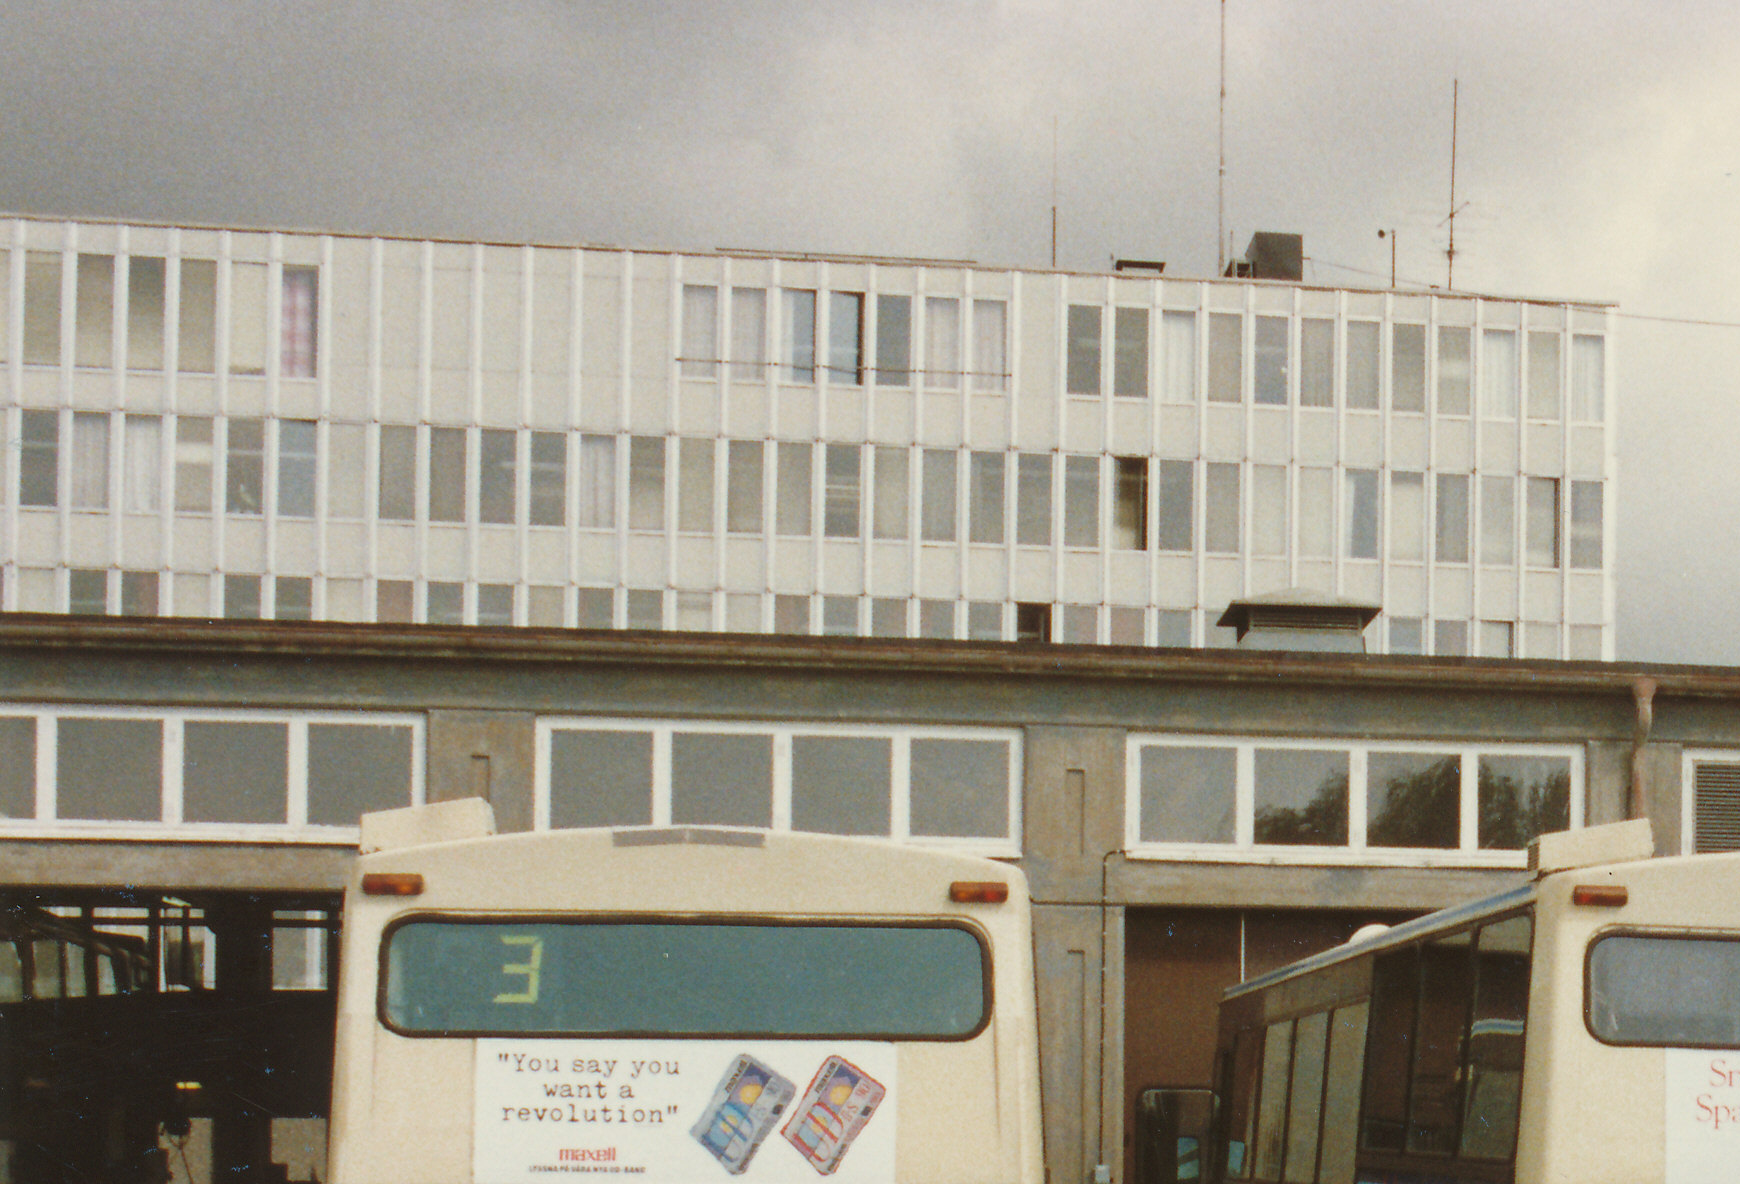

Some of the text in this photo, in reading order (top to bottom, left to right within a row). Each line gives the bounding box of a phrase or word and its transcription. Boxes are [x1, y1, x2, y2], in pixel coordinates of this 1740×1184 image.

[493, 935, 544, 1004] 3
[498, 1053, 680, 1079] "You say you
[543, 1080, 635, 1099] want a
[502, 1104, 679, 1124] revolution"
[558, 1147, 616, 1161] maxell
